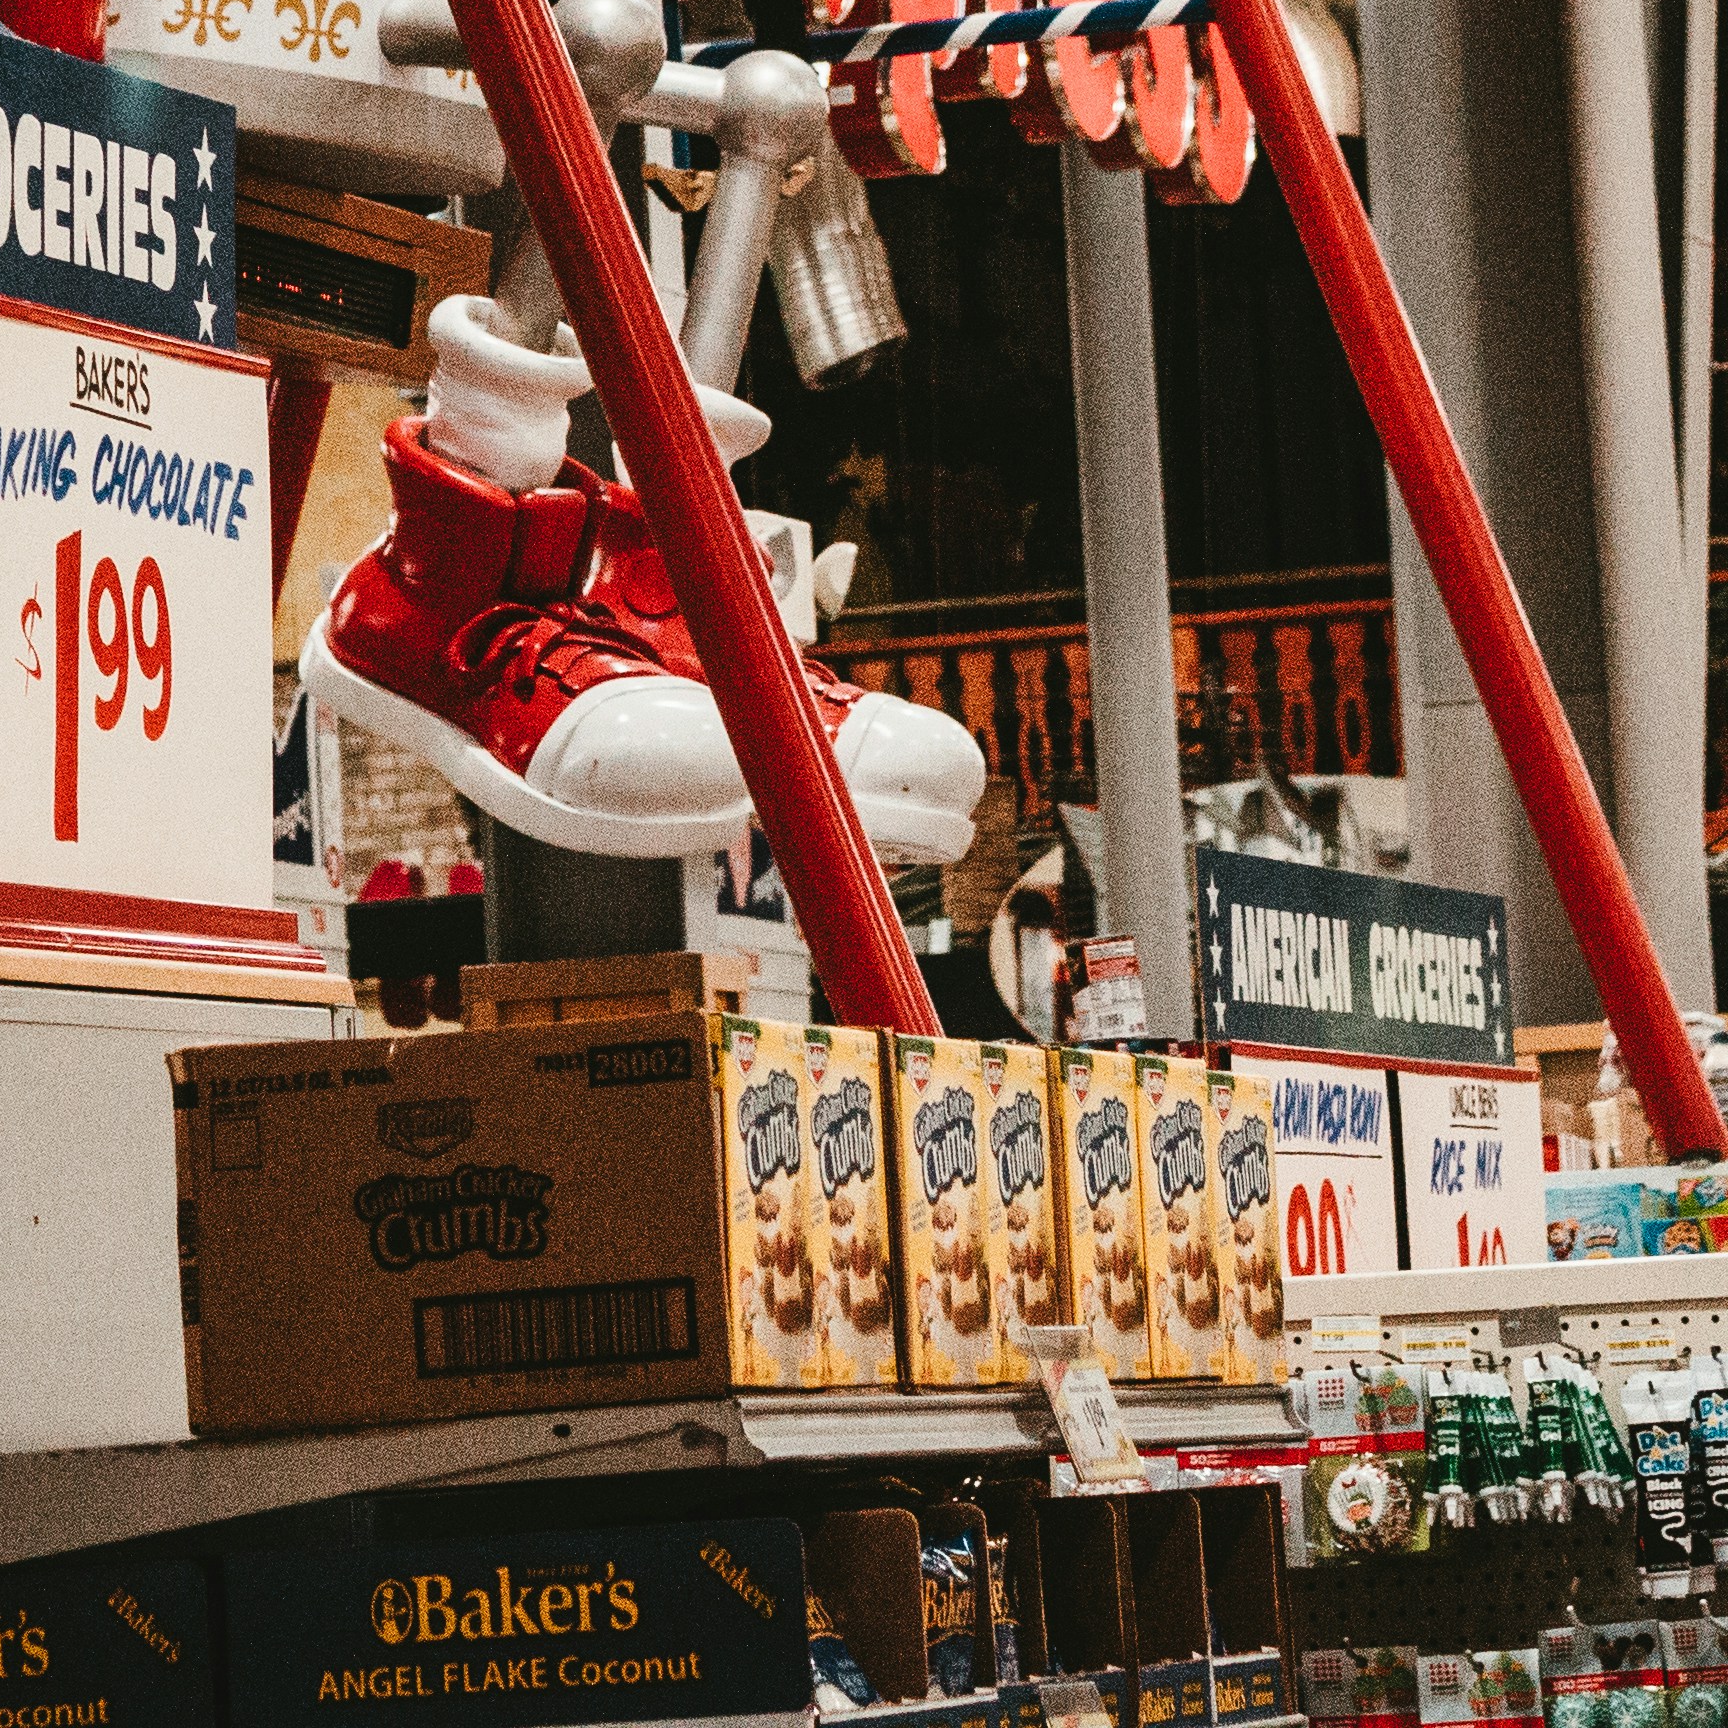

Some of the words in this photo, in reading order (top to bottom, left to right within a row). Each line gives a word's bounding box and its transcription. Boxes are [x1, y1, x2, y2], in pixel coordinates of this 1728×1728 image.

[75, 345, 152, 416] BAKER'S
[91, 431, 257, 542] CHOCOLATE
[1230, 902, 1353, 1014] AMERICAN
[1369, 921, 1487, 1032] GROCERIES
[358, 1180, 452, 1217] Graham
[455, 1168, 544, 1199] Cracker
[1430, 1137, 1466, 1196] RICE
[1475, 1139, 1503, 1191] MIX
[376, 1199, 540, 1264] Crumbs
[1638, 1457, 1688, 1476] Cake
[414, 1560, 641, 1643] Baker's
[712, 1544, 779, 1620] Baker's
[118, 1591, 183, 1664] Baker's
[317, 1663, 434, 1703] ANGEL
[443, 1657, 550, 1694] FLAKE
[557, 1650, 703, 1688] Coconut
